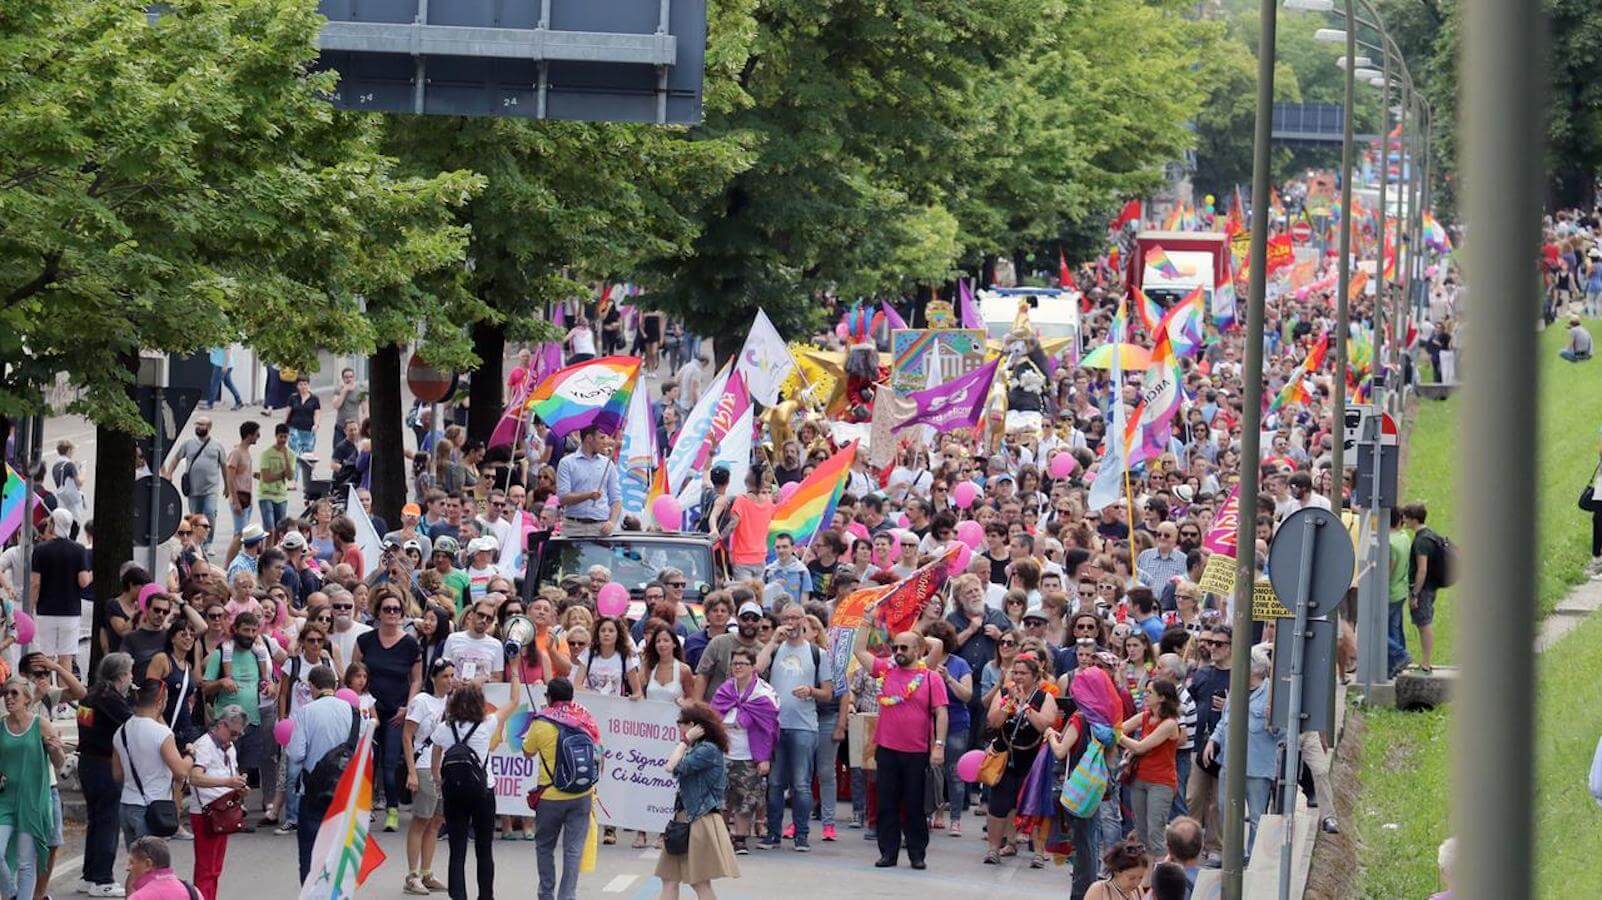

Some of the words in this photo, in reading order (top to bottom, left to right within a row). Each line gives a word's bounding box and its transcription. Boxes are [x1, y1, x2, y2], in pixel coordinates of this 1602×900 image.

[503, 97, 518, 106] 24
[608, 719, 621, 734] 18
[622, 721, 660, 740] GIUGNO
[661, 726, 677, 742] 20
[491, 755, 534, 777] EVISO
[604, 749, 613, 759] e
[615, 750, 624, 760] e
[626, 749, 669, 771] Signo
[611, 767, 628, 782] Ci
[494, 777, 522, 797] RIDE
